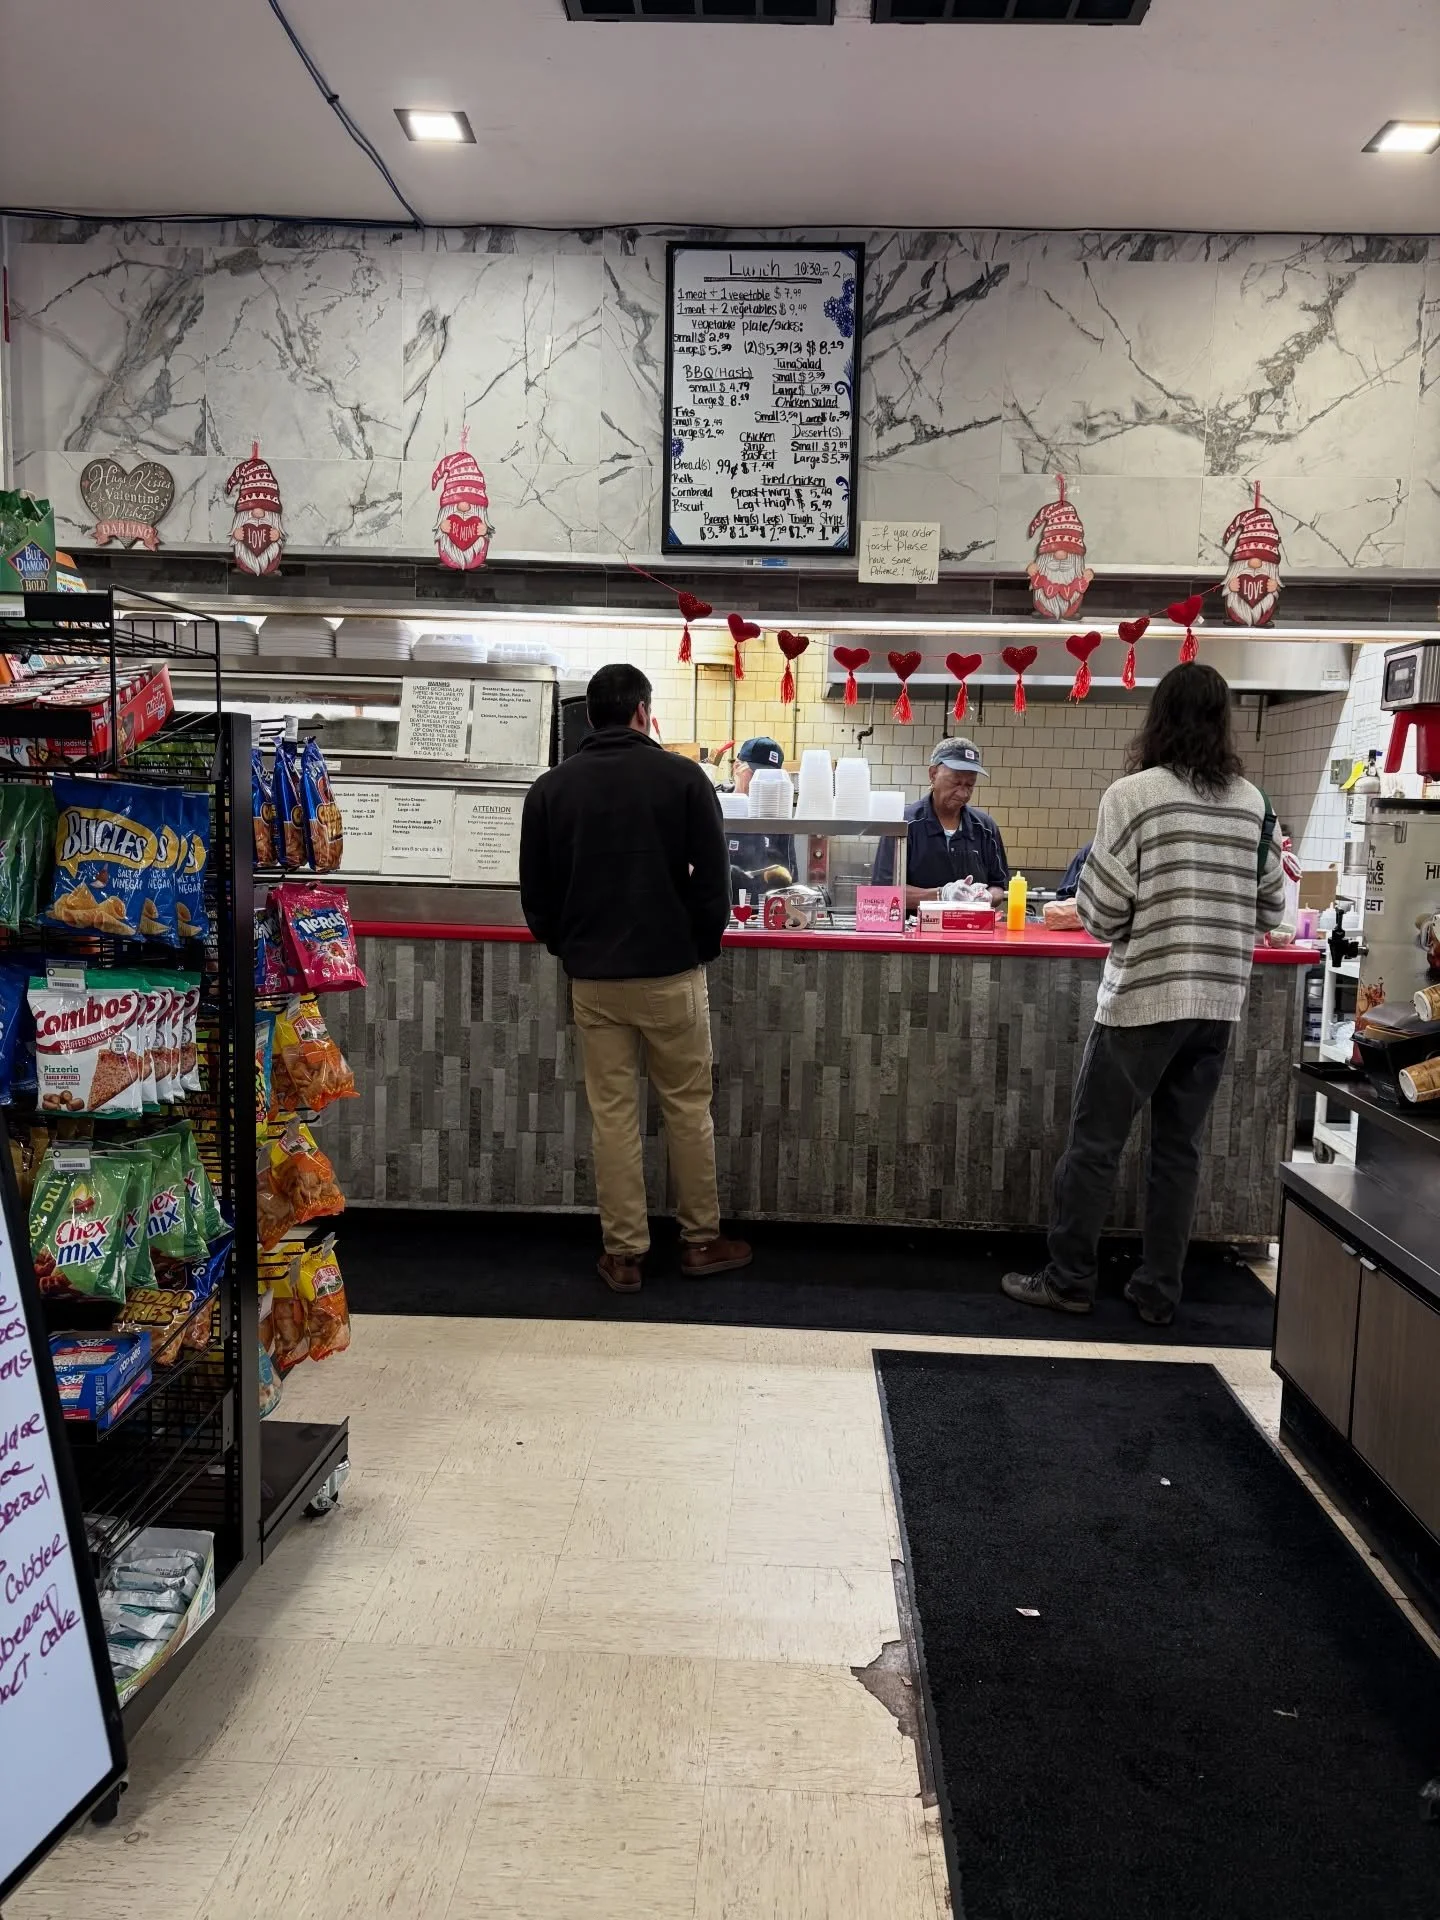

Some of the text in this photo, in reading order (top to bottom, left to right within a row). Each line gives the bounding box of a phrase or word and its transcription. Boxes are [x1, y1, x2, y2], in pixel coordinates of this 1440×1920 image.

[105, 488, 160, 504] Valentine
[102, 522, 152, 538] DARLING
[452, 521, 477, 541] BE MINE
[893, 529, 909, 541] you
[912, 525, 937, 538] order
[248, 528, 267, 549] LOVE
[25, 546, 42, 561] BLUE
[16, 557, 50, 572] DIAMOND
[1243, 579, 1264, 600] LOVE
[472, 805, 511, 813] ATTENTION
[62, 811, 148, 862] BUGLES
[117, 868, 133, 878] SALT
[1365, 899, 1384, 911] EET
[35, 993, 133, 1040] Combos
[44, 1065, 79, 1073] Pizzeria
[56, 1215, 111, 1245] Chex
